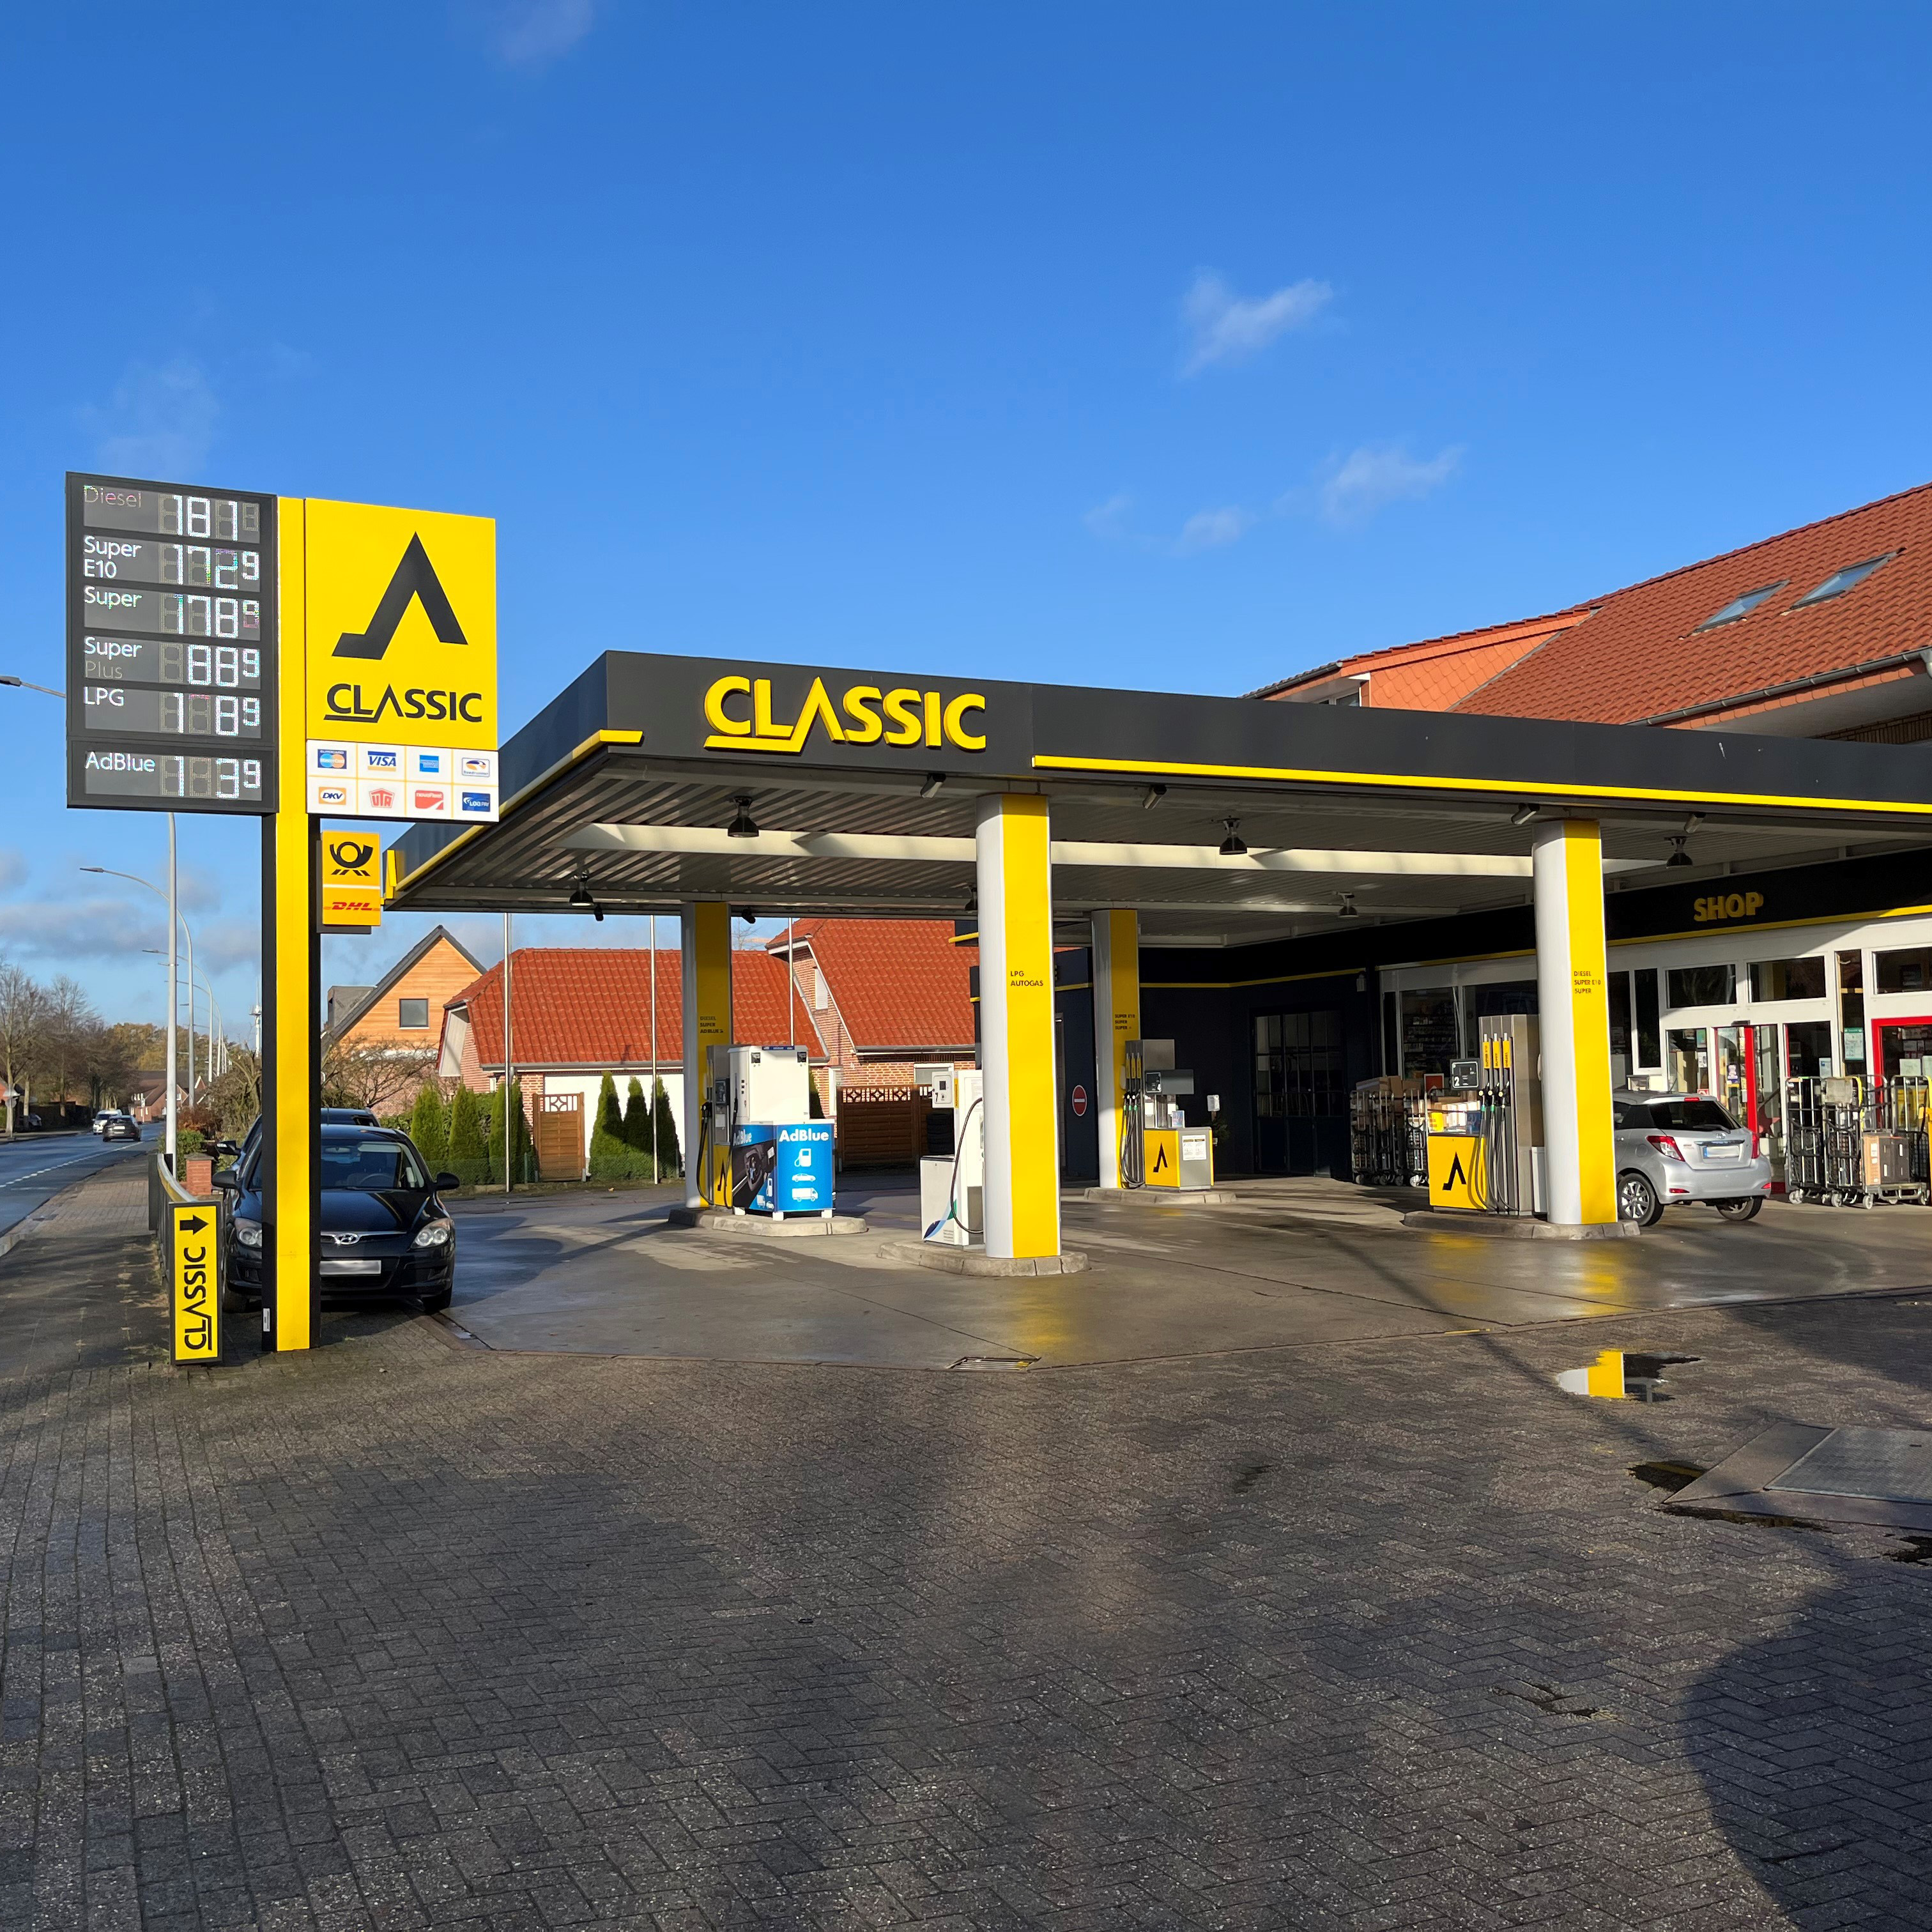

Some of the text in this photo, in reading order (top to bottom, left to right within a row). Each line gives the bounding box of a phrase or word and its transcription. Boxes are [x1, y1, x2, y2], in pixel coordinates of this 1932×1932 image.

[84, 485, 142, 508] Diesel
[84, 535, 142, 559] Super
[84, 558, 117, 579] E10
[84, 586, 142, 610] Super
[84, 636, 142, 660] Super
[85, 660, 123, 679] Plus
[84, 686, 124, 707] LPG
[323, 682, 482, 724] CLASSIC
[703, 675, 986, 756] CLASSIC
[85, 751, 156, 772] AdBlue
[369, 756, 397, 767] VISA
[371, 790, 393, 806] UTA
[332, 901, 372, 910] DHL
[1693, 891, 1764, 922] SHOP
[1454, 1076, 1460, 1086] 2
[733, 1129, 753, 1146] AdBlue
[779, 1128, 829, 1142] AdBlue
[181, 1246, 212, 1351] CLASSIC
